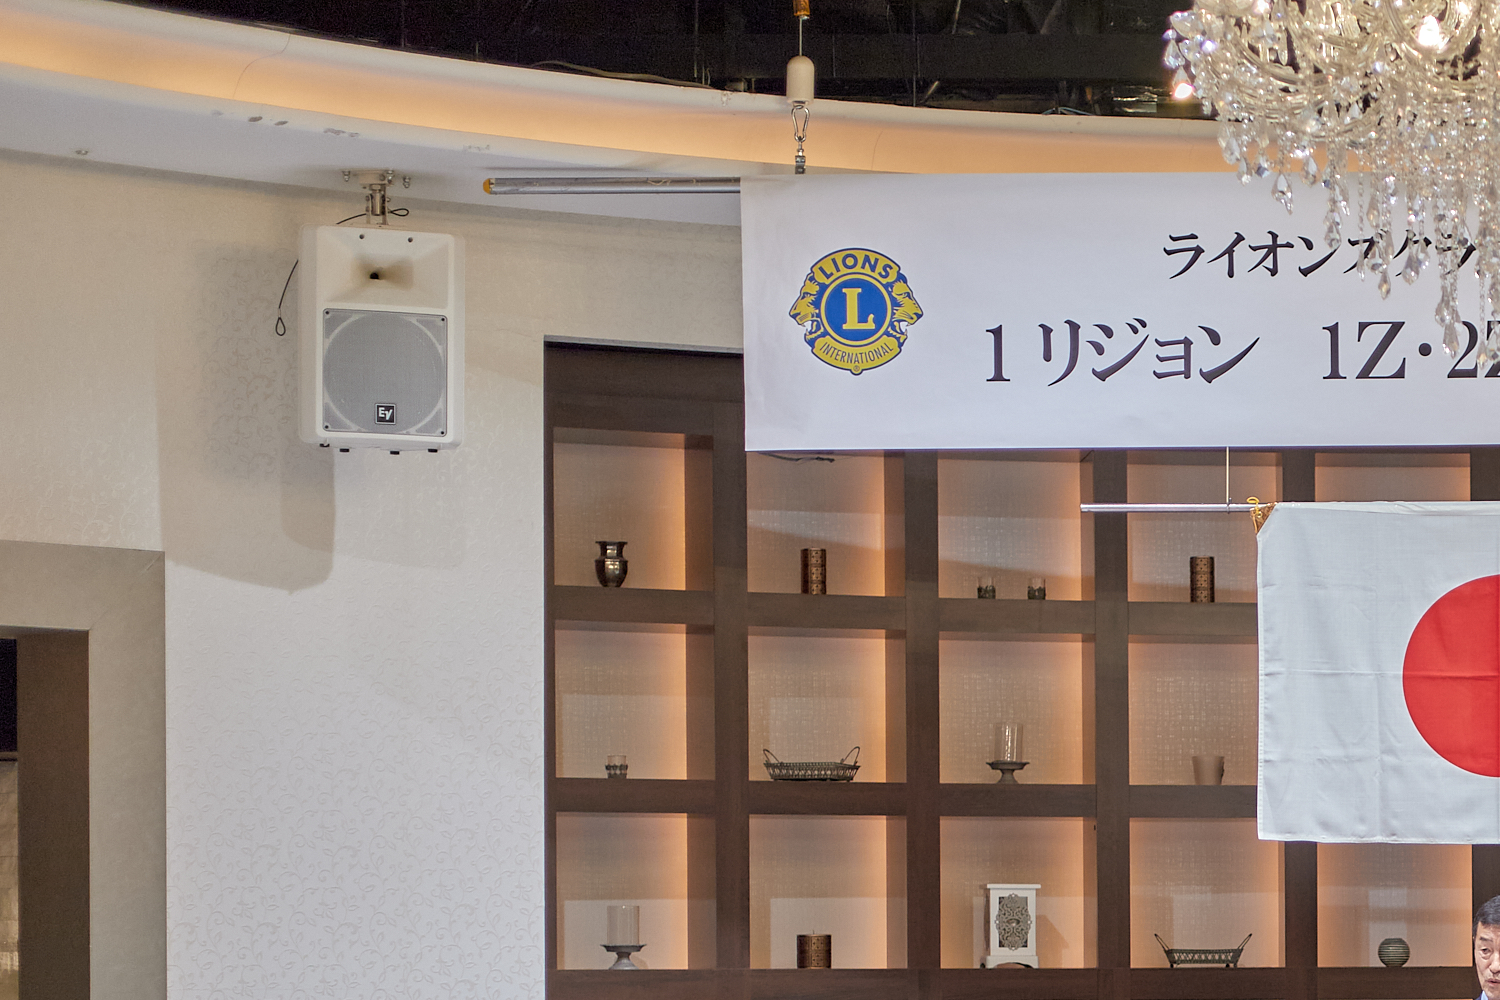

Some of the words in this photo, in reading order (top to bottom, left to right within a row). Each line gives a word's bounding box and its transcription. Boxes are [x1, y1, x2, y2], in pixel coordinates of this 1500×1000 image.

[818, 253, 894, 280] LIONS
[842, 287, 876, 330] L
[820, 342, 894, 364] INTERNATIONAL
